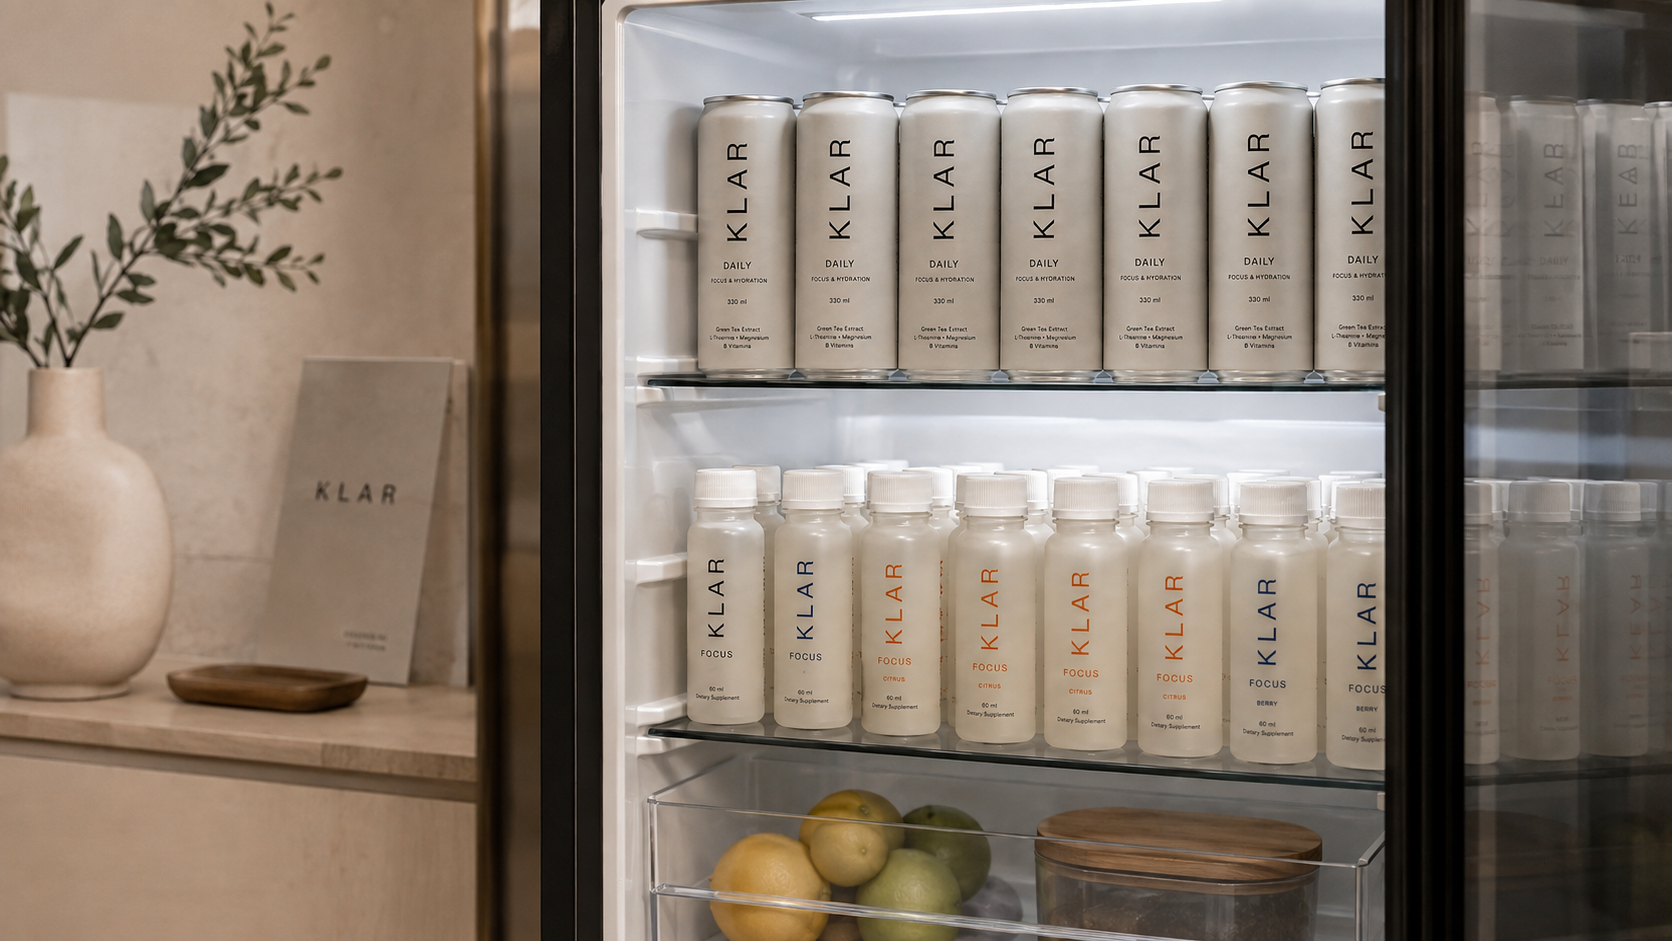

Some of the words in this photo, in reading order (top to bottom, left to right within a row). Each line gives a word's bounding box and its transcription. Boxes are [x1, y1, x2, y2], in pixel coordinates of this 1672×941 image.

[829, 140, 851, 239] KLAR
[933, 140, 955, 239] KLAR
[1033, 138, 1055, 238] KLAR
[1138, 136, 1161, 237] KLAR
[1247, 134, 1270, 236] KLAR
[1351, 131, 1374, 234] KLAR
[727, 143, 748, 241] KLAR
[724, 261, 752, 270] DAILY
[826, 259, 855, 268] DAILY
[930, 259, 959, 268] DAILY
[1030, 258, 1059, 267] DAILY
[1135, 257, 1165, 266] DAILY
[1244, 256, 1275, 265] DAILY
[1348, 255, 1379, 264] DAILY
[315, 480, 398, 506] KLAR
[708, 558, 724, 638] KLAR
[797, 560, 813, 640] KLAR
[885, 563, 902, 645] KLAR
[980, 568, 998, 650] KLAR
[1071, 572, 1090, 656] KLAR
[1165, 575, 1183, 660] KLAR
[1258, 578, 1276, 666] KLAR
[1356, 582, 1376, 671] KLAR
[700, 649, 733, 659] FOCUS
[790, 652, 823, 661] FOCUS
[877, 656, 912, 666] FOCUS
[972, 662, 1008, 673] FOCUS
[1063, 668, 1100, 678] FOCUS
[883, 675, 905, 683] CITRUS
[1157, 673, 1194, 683] FOCUS
[1249, 678, 1287, 689] FOCUS
[1348, 684, 1386, 695] FOCUS
